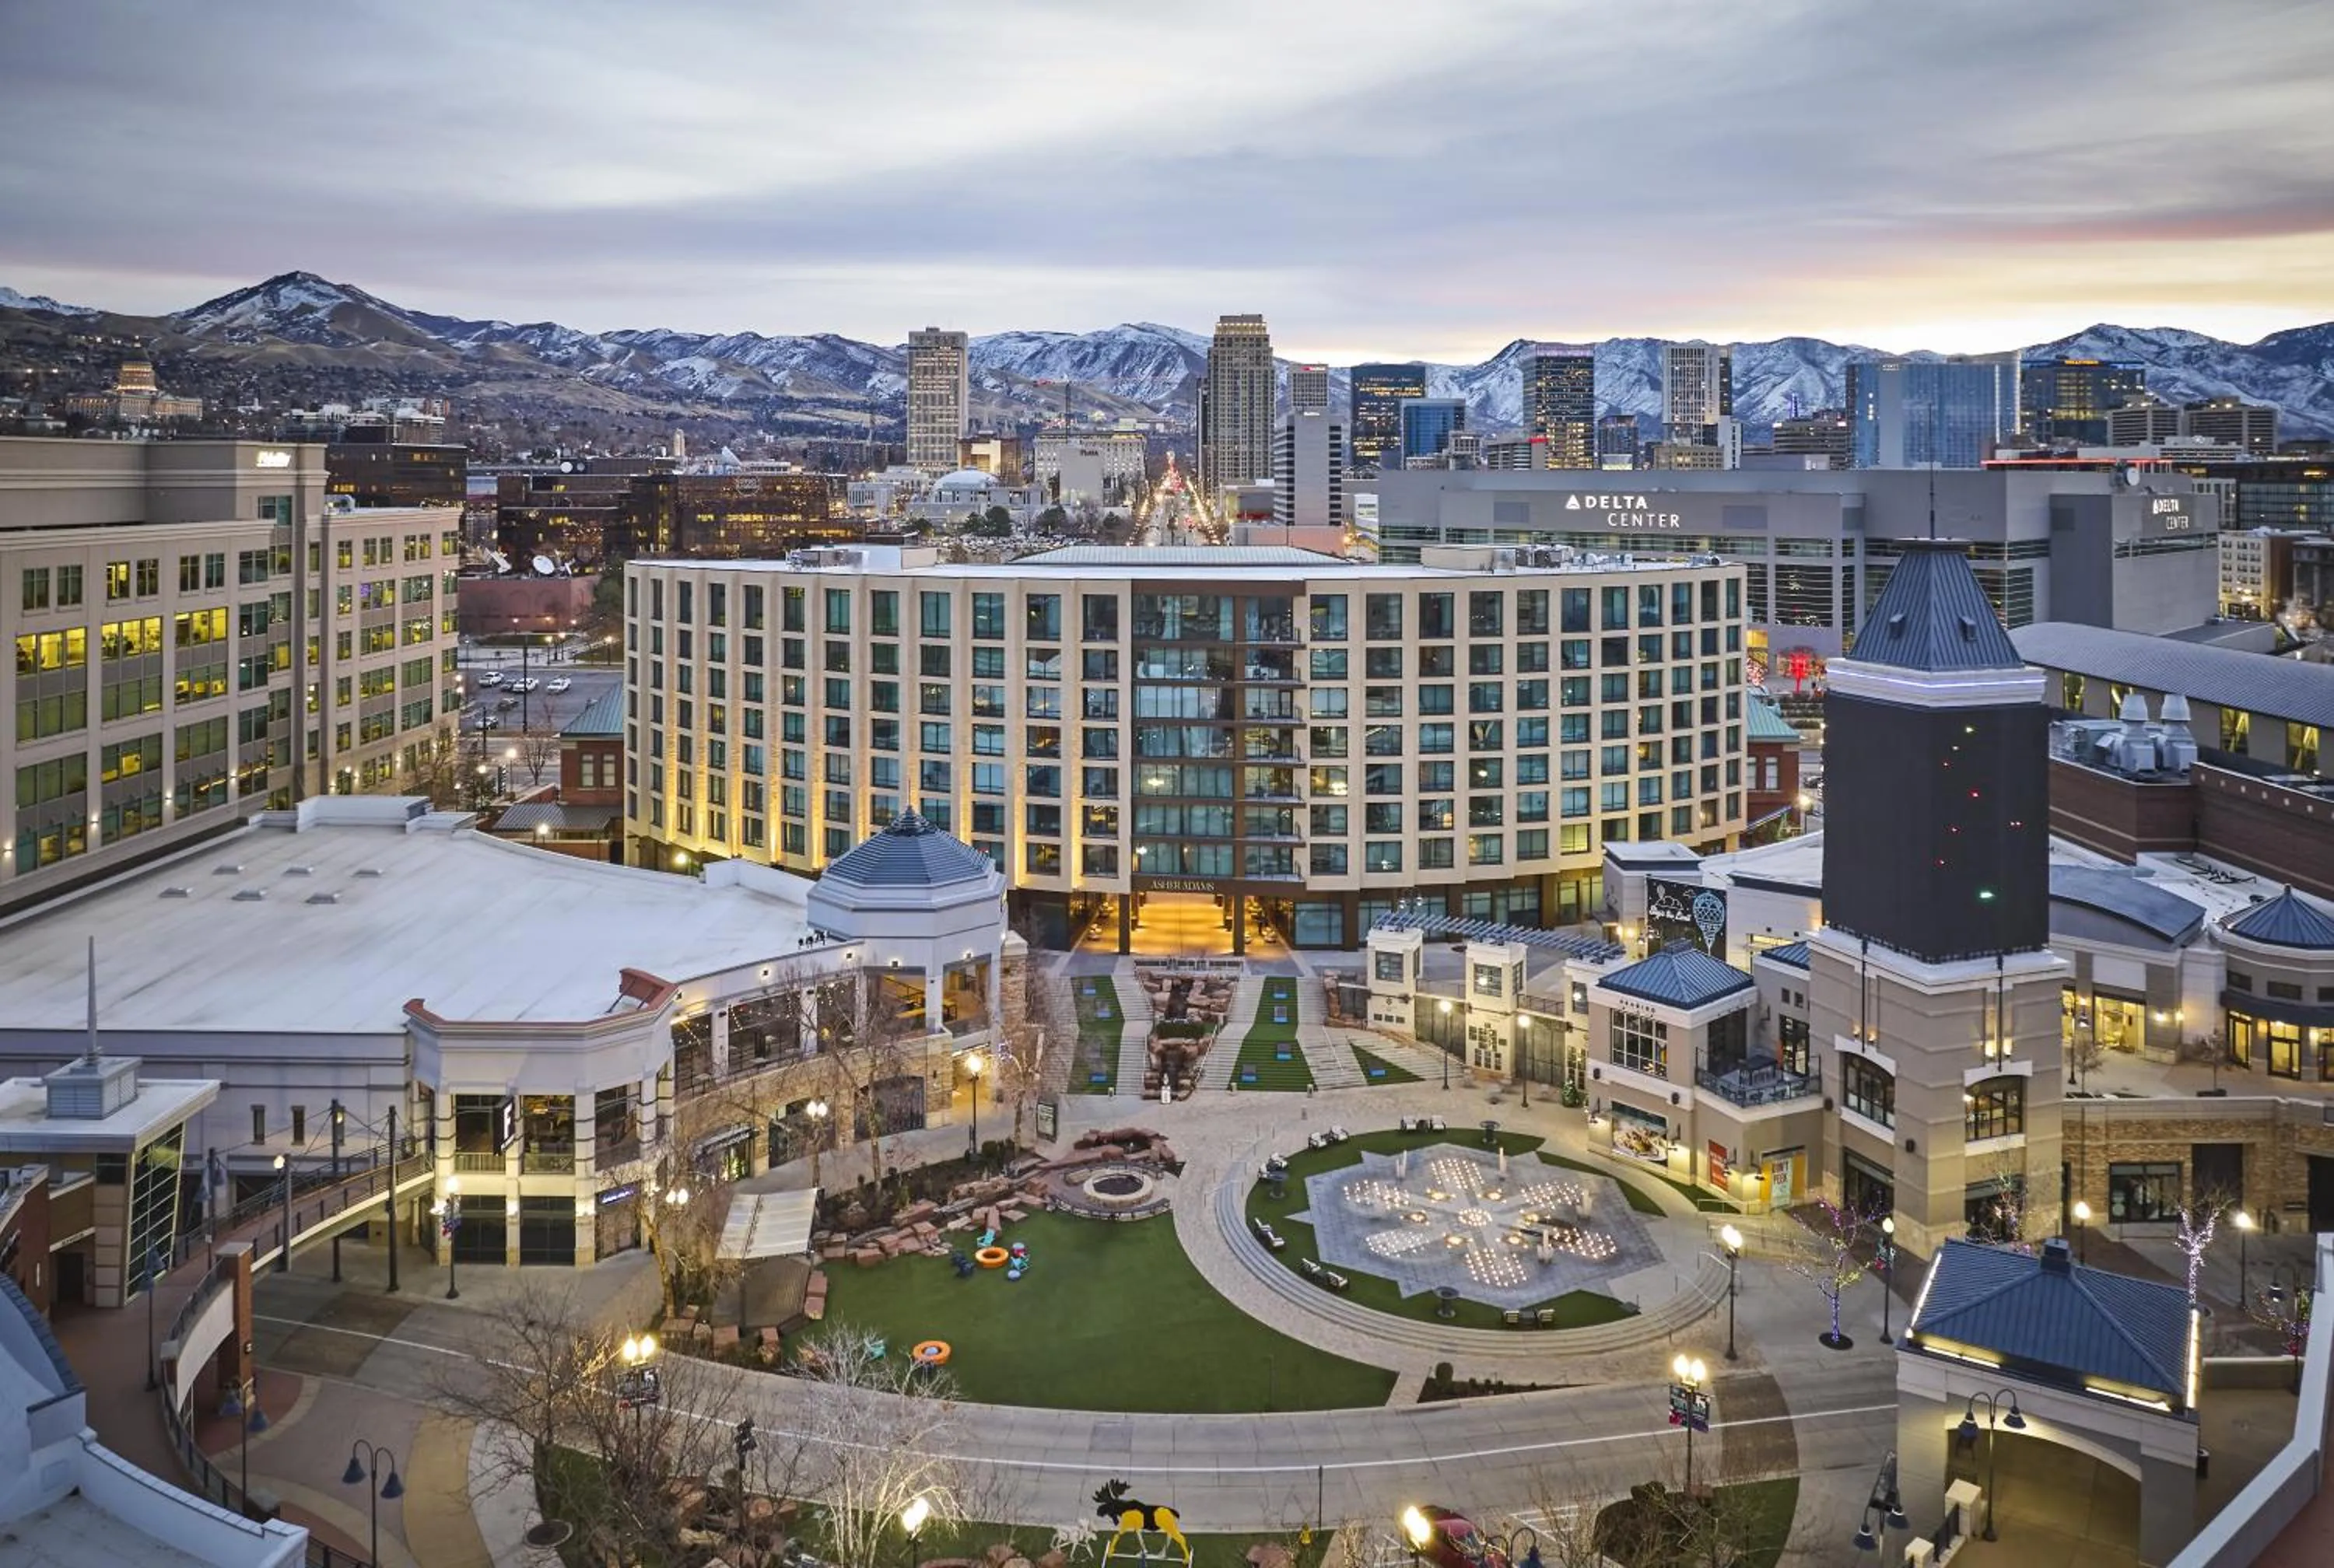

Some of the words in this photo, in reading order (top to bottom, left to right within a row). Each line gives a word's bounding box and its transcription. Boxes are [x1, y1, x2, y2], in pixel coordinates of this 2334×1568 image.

[1585, 495, 1648, 510] DELTA
[2158, 499, 2179, 513] DELTA
[1607, 513, 1680, 528] CENTER
[2165, 516, 2189, 530] CENTER
[1151, 880, 1181, 890] ASHER
[1182, 880, 1215, 891] ADAMS
